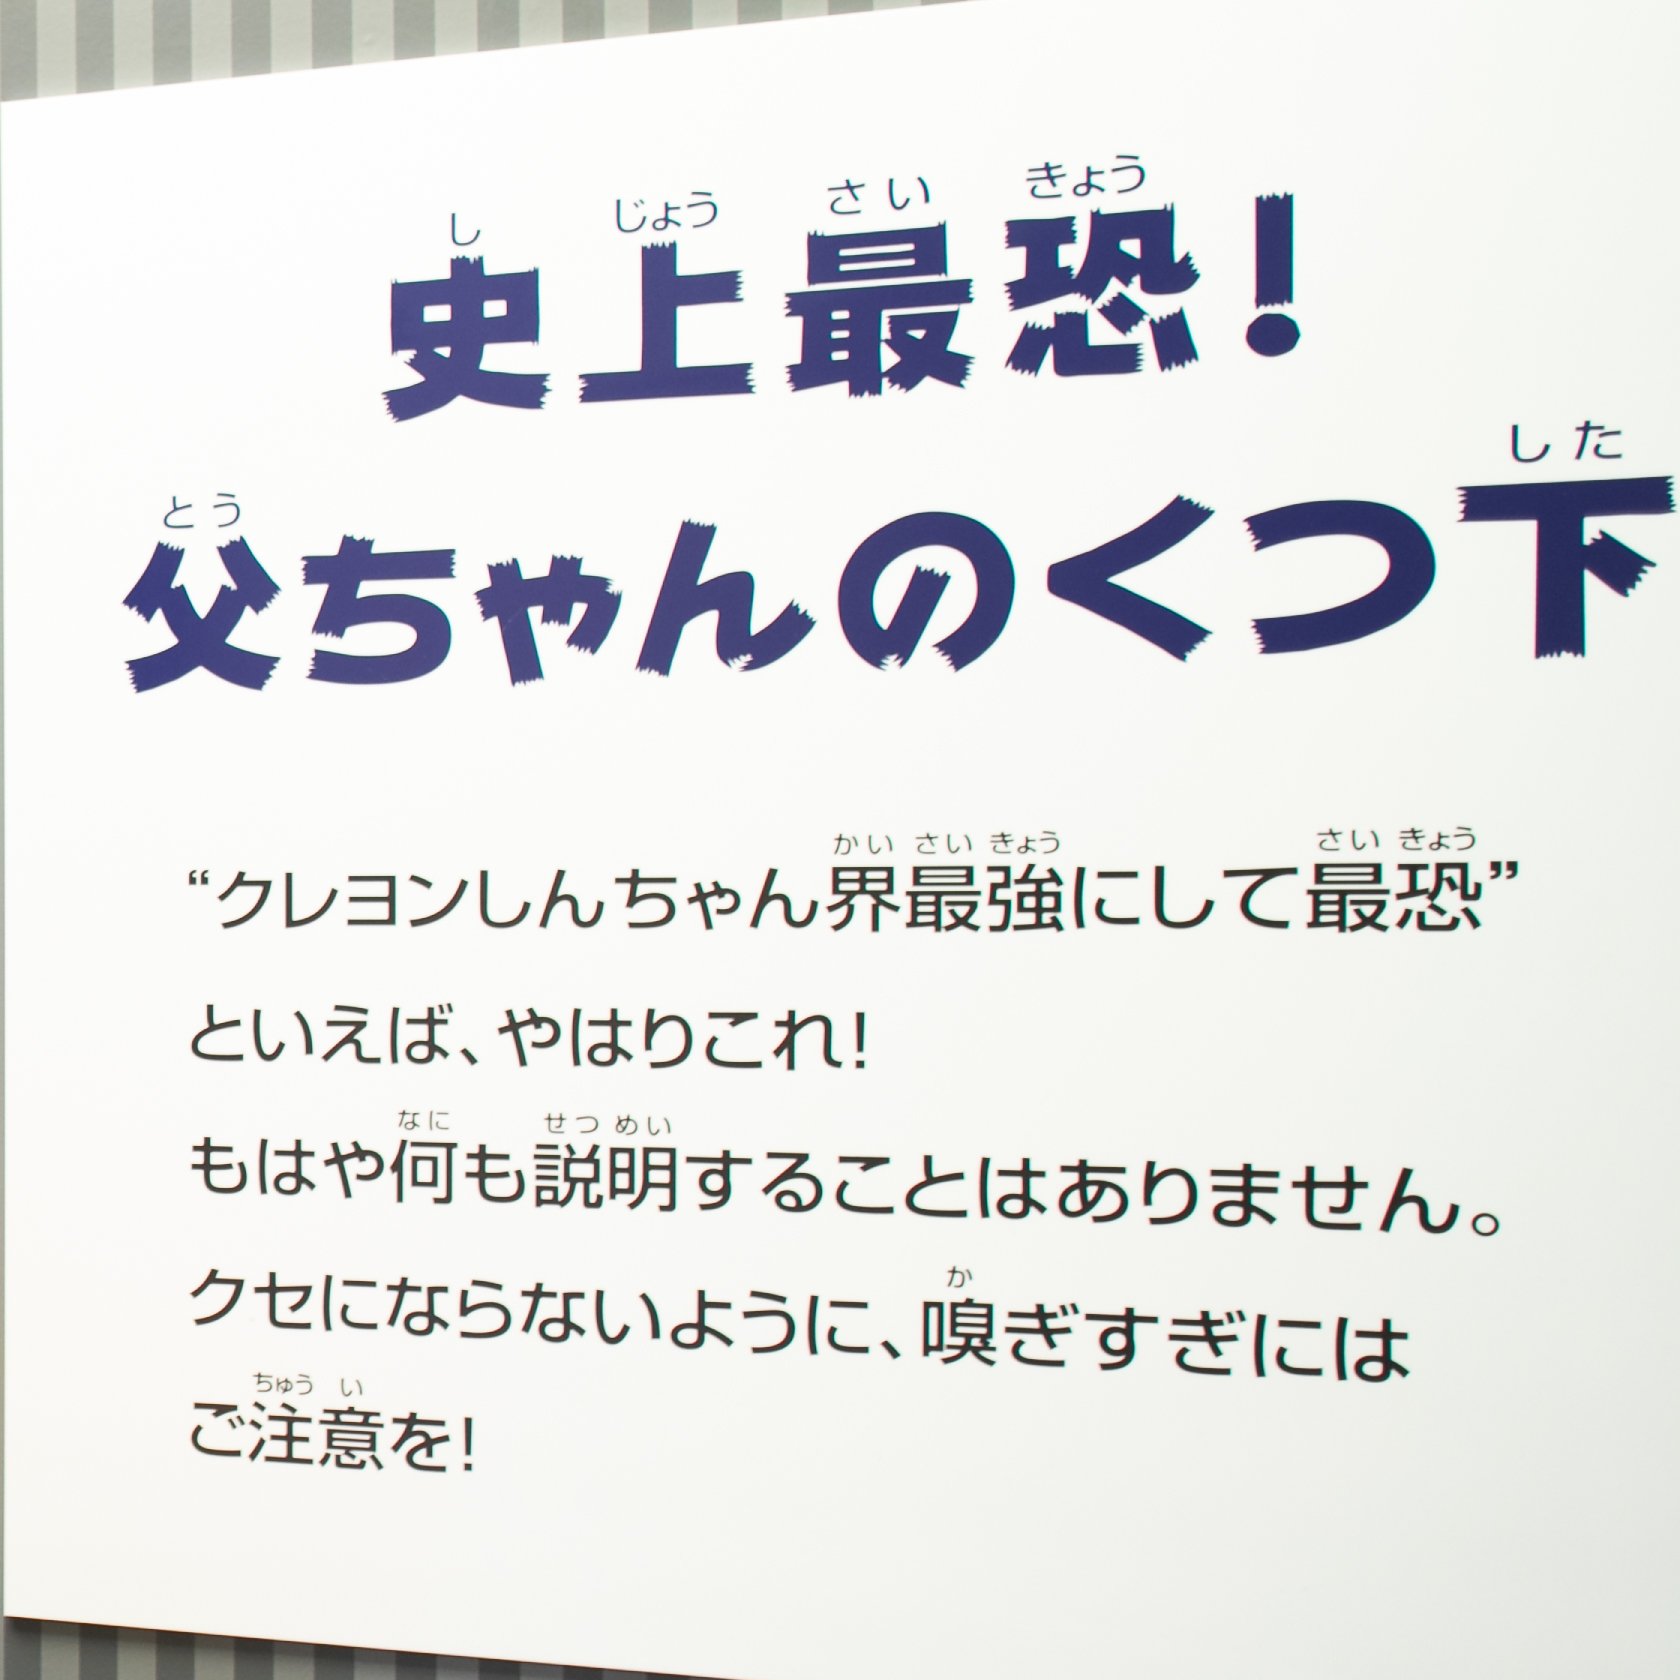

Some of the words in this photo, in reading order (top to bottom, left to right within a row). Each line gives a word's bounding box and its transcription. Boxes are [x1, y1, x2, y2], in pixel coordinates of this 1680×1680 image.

[452, 213, 480, 246] し
[616, 192, 717, 233] じょう
[828, 177, 929, 215] さい
[1026, 155, 1145, 198] きょう
[382, 192, 1300, 422] 史上最恐！
[164, 493, 240, 528] とう
[1512, 420, 1622, 463] した
[123, 476, 1676, 693] 父ちゃんのくつ下
[835, 834, 892, 855] かい
[917, 833, 971, 854] さい
[991, 831, 1059, 854] きょう
[1318, 829, 1379, 851] さい
[1400, 827, 1475, 851] きょう
[191, 1003, 865, 1071] といえば、やはりこれ！
[399, 1110, 448, 1130] なに
[545, 1114, 598, 1133] せつ
[616, 1115, 670, 1135] めい
[192, 1137, 1499, 1236] もはや何も説明することはありません。
[948, 1266, 972, 1288] か
[190, 1269, 1409, 1383] クセにならないように、嗅ぎすぎには
[254, 1373, 312, 1395] ちゅう
[342, 1379, 362, 1396] い
[191, 1401, 472, 1472] ご注意を！
